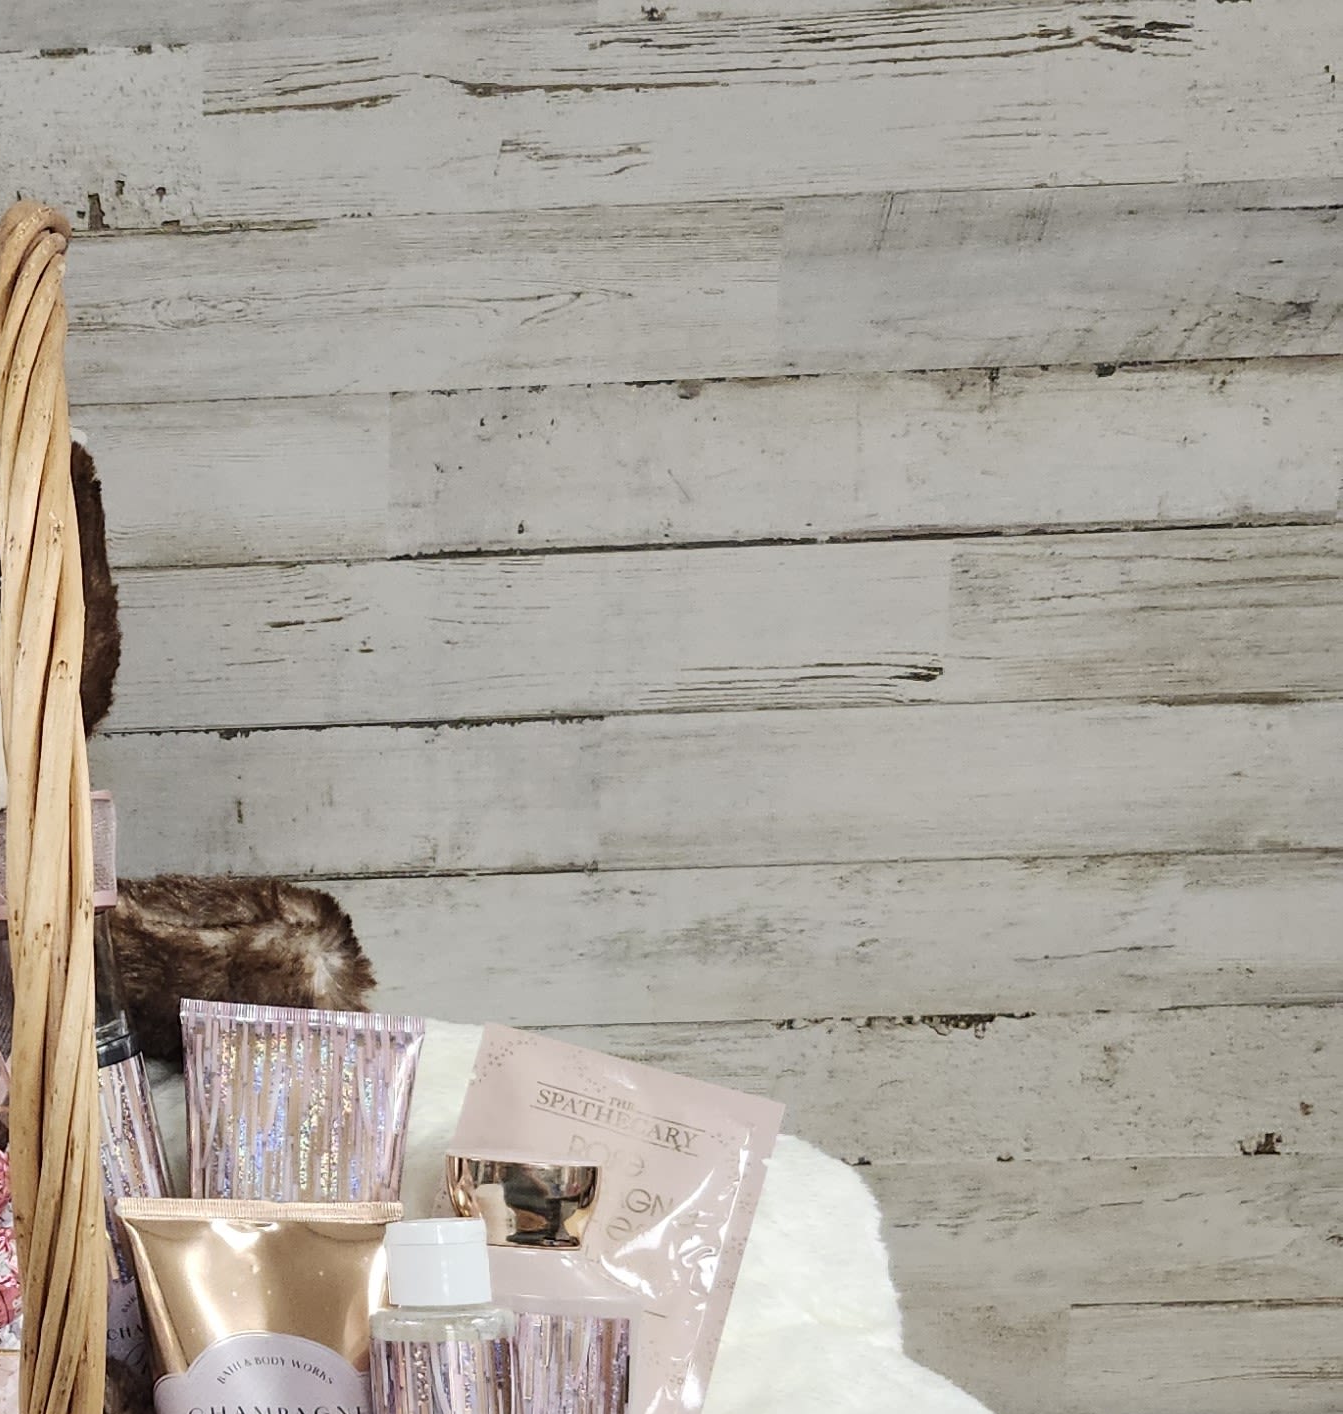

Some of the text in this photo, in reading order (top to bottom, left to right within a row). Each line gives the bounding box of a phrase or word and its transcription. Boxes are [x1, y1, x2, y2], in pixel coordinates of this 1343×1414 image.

[536, 1087, 700, 1150] SPATHECARY
[217, 1361, 242, 1385] BATH
[254, 1356, 286, 1366] BODY
[291, 1359, 334, 1385] WORKS
